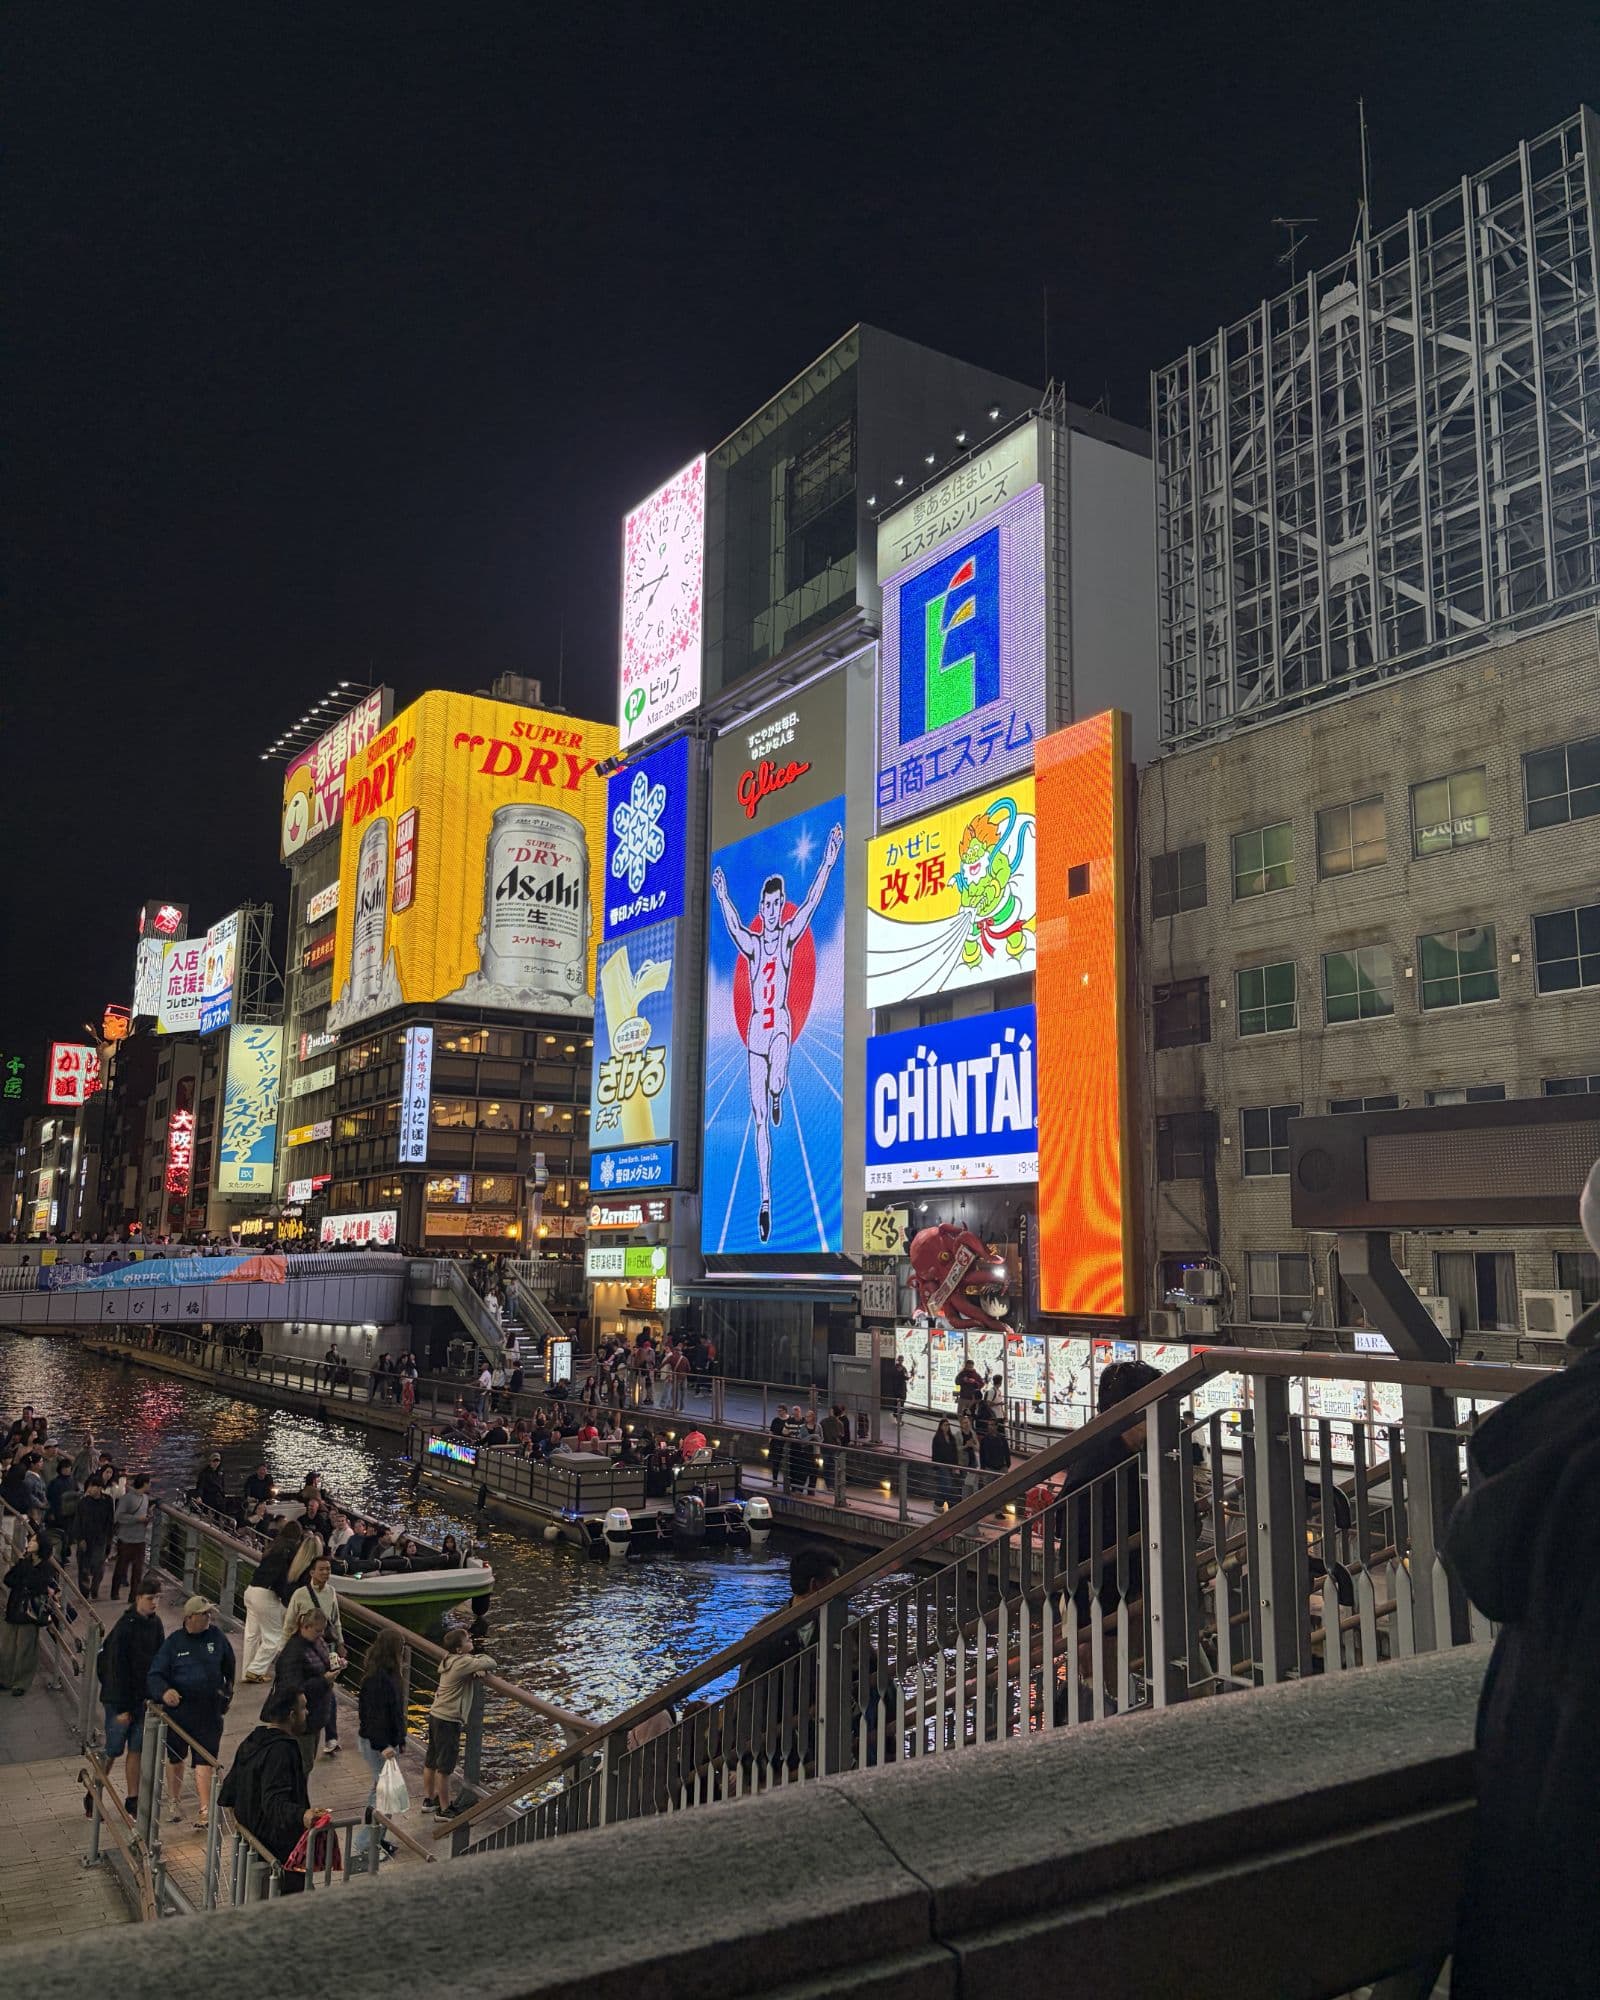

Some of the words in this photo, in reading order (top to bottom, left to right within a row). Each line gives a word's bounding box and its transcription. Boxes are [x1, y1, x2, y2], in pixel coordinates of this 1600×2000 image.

[913, 459, 992, 526] 夢ある住まい
[900, 475, 1008, 562] エステムシリーズ
[649, 665, 682, 706] ピップ
[510, 720, 583, 750] SUPER
[751, 729, 795, 760] ゆたかな人生
[877, 710, 1034, 809] 日商エステム
[737, 760, 811, 819] Glico
[525, 839, 557, 850] SUPER
[886, 830, 940, 867] かぜに
[496, 864, 580, 911] Asahi
[880, 852, 946, 911] 改源
[527, 908, 548, 925] 生
[609, 889, 667, 927] 雪印メグミルク
[512, 935, 562, 949] スーパードライ
[762, 956, 777, 1030] グリコ
[597, 1045, 667, 1105] さける
[410, 1095, 426, 1157] かに道楽
[596, 1105, 622, 1132] チーズ
[616, 1164, 662, 1184] 雪印メグミルク
[105, 1301, 200, 1315] えびす橋
[1356, 1337, 1378, 1348] BAR
